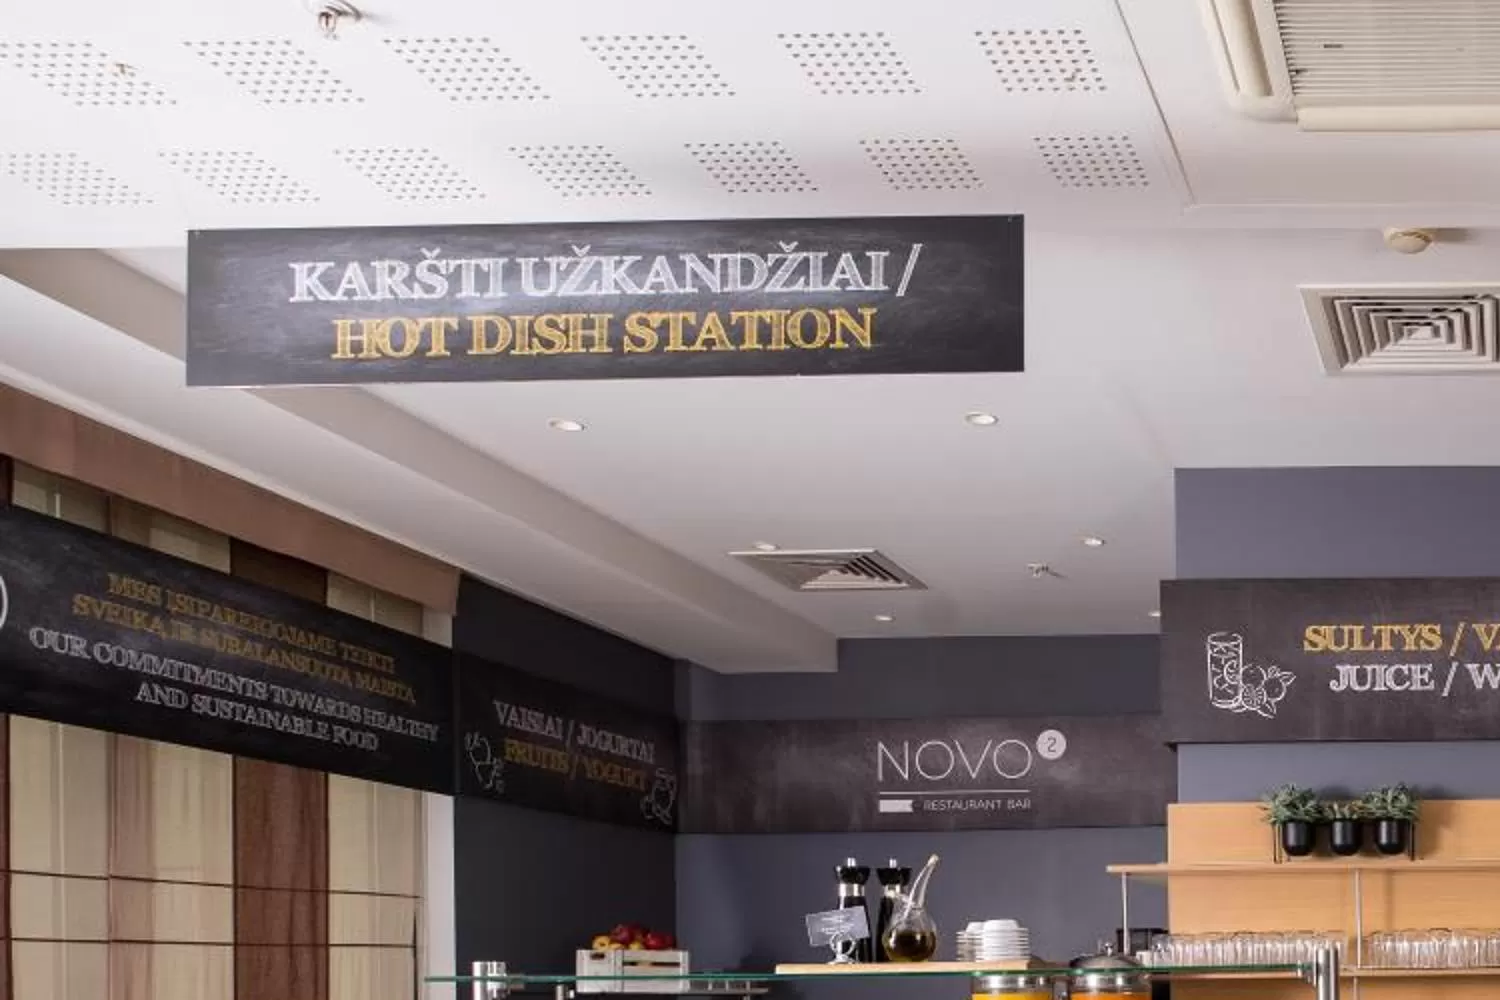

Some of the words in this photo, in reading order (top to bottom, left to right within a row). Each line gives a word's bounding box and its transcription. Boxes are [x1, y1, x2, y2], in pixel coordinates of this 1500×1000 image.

[288, 247, 505, 303] KARŠTI
[519, 242, 890, 295] UŽKANDŽIAI
[331, 317, 459, 358] HOT
[466, 314, 612, 355] DISH
[622, 307, 878, 354] STATION
[1303, 624, 1444, 653] SULTYS
[29, 626, 92, 660] OUR
[93, 641, 268, 702] COMMITMENTS
[269, 683, 362, 723] TOWARDS
[363, 707, 440, 742] HEALTHY
[1328, 662, 1436, 693] JUICE
[135, 681, 190, 710] AND
[190, 693, 331, 742] SUSTAINABLE
[331, 724, 380, 751] FOOD
[878, 739, 1032, 781] NOVO
[923, 799, 1003, 812] RESTAURANT
[1007, 798, 1032, 810] BAR
